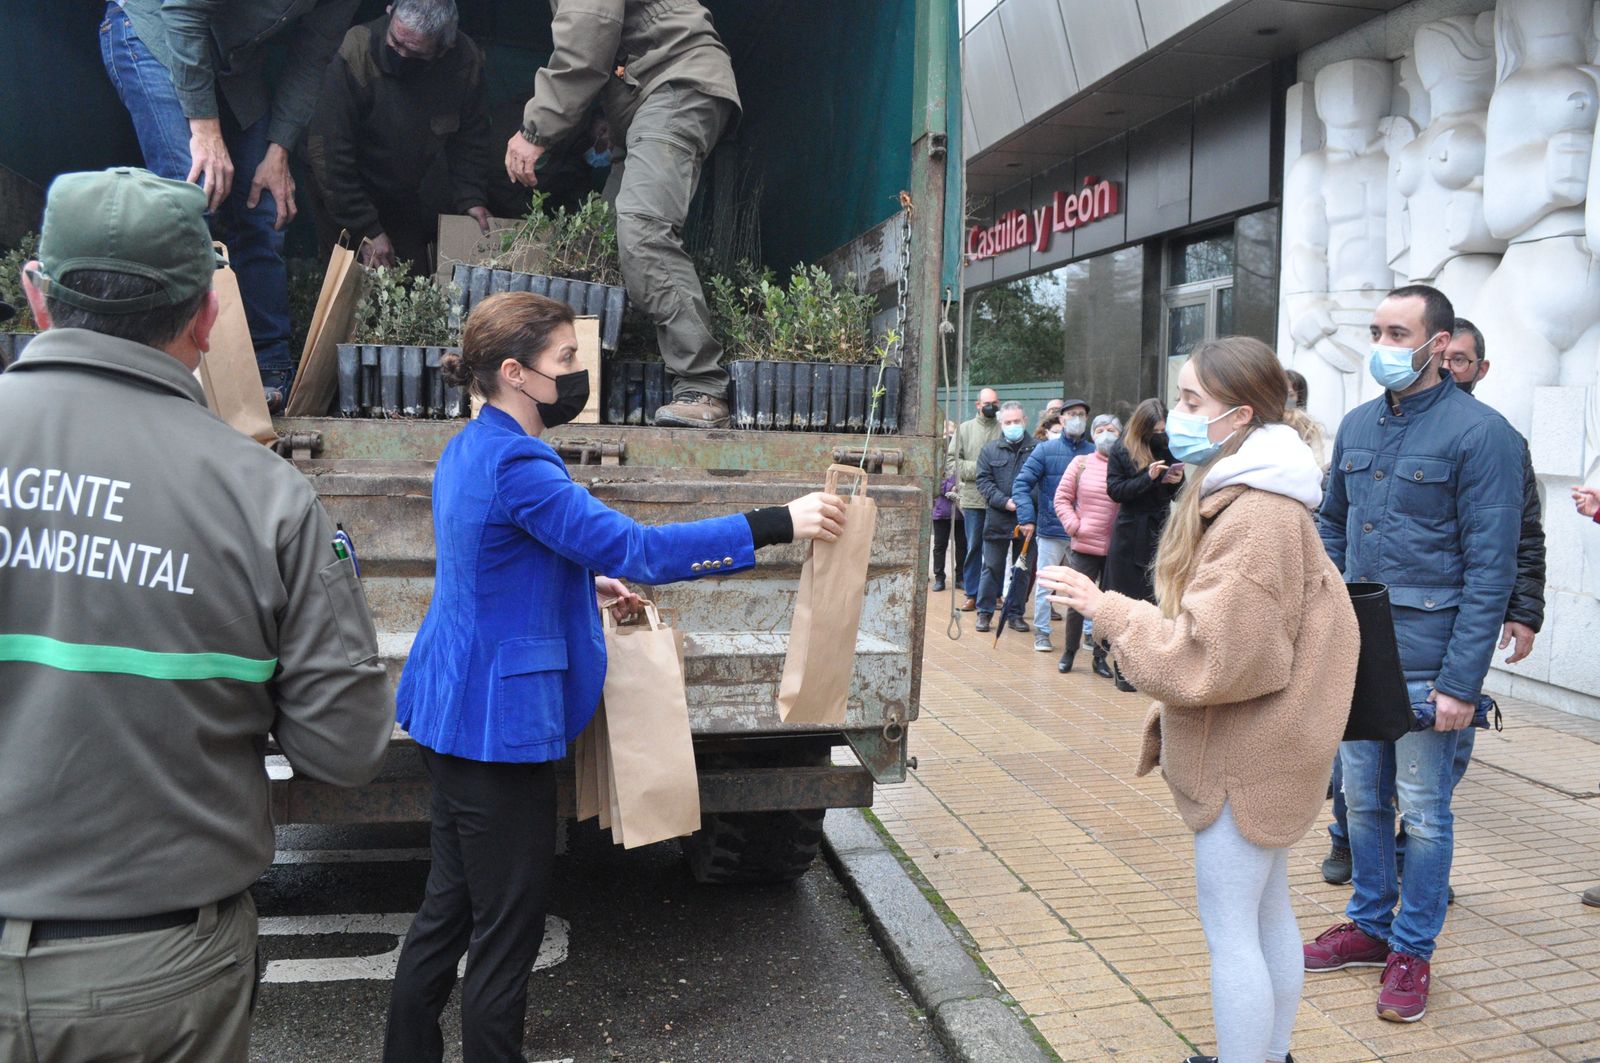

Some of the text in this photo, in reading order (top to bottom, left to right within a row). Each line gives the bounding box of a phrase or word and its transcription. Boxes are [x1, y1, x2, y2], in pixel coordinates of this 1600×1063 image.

[967, 175, 1118, 261] Castilla y León
[0, 467, 131, 522] AGENTE
